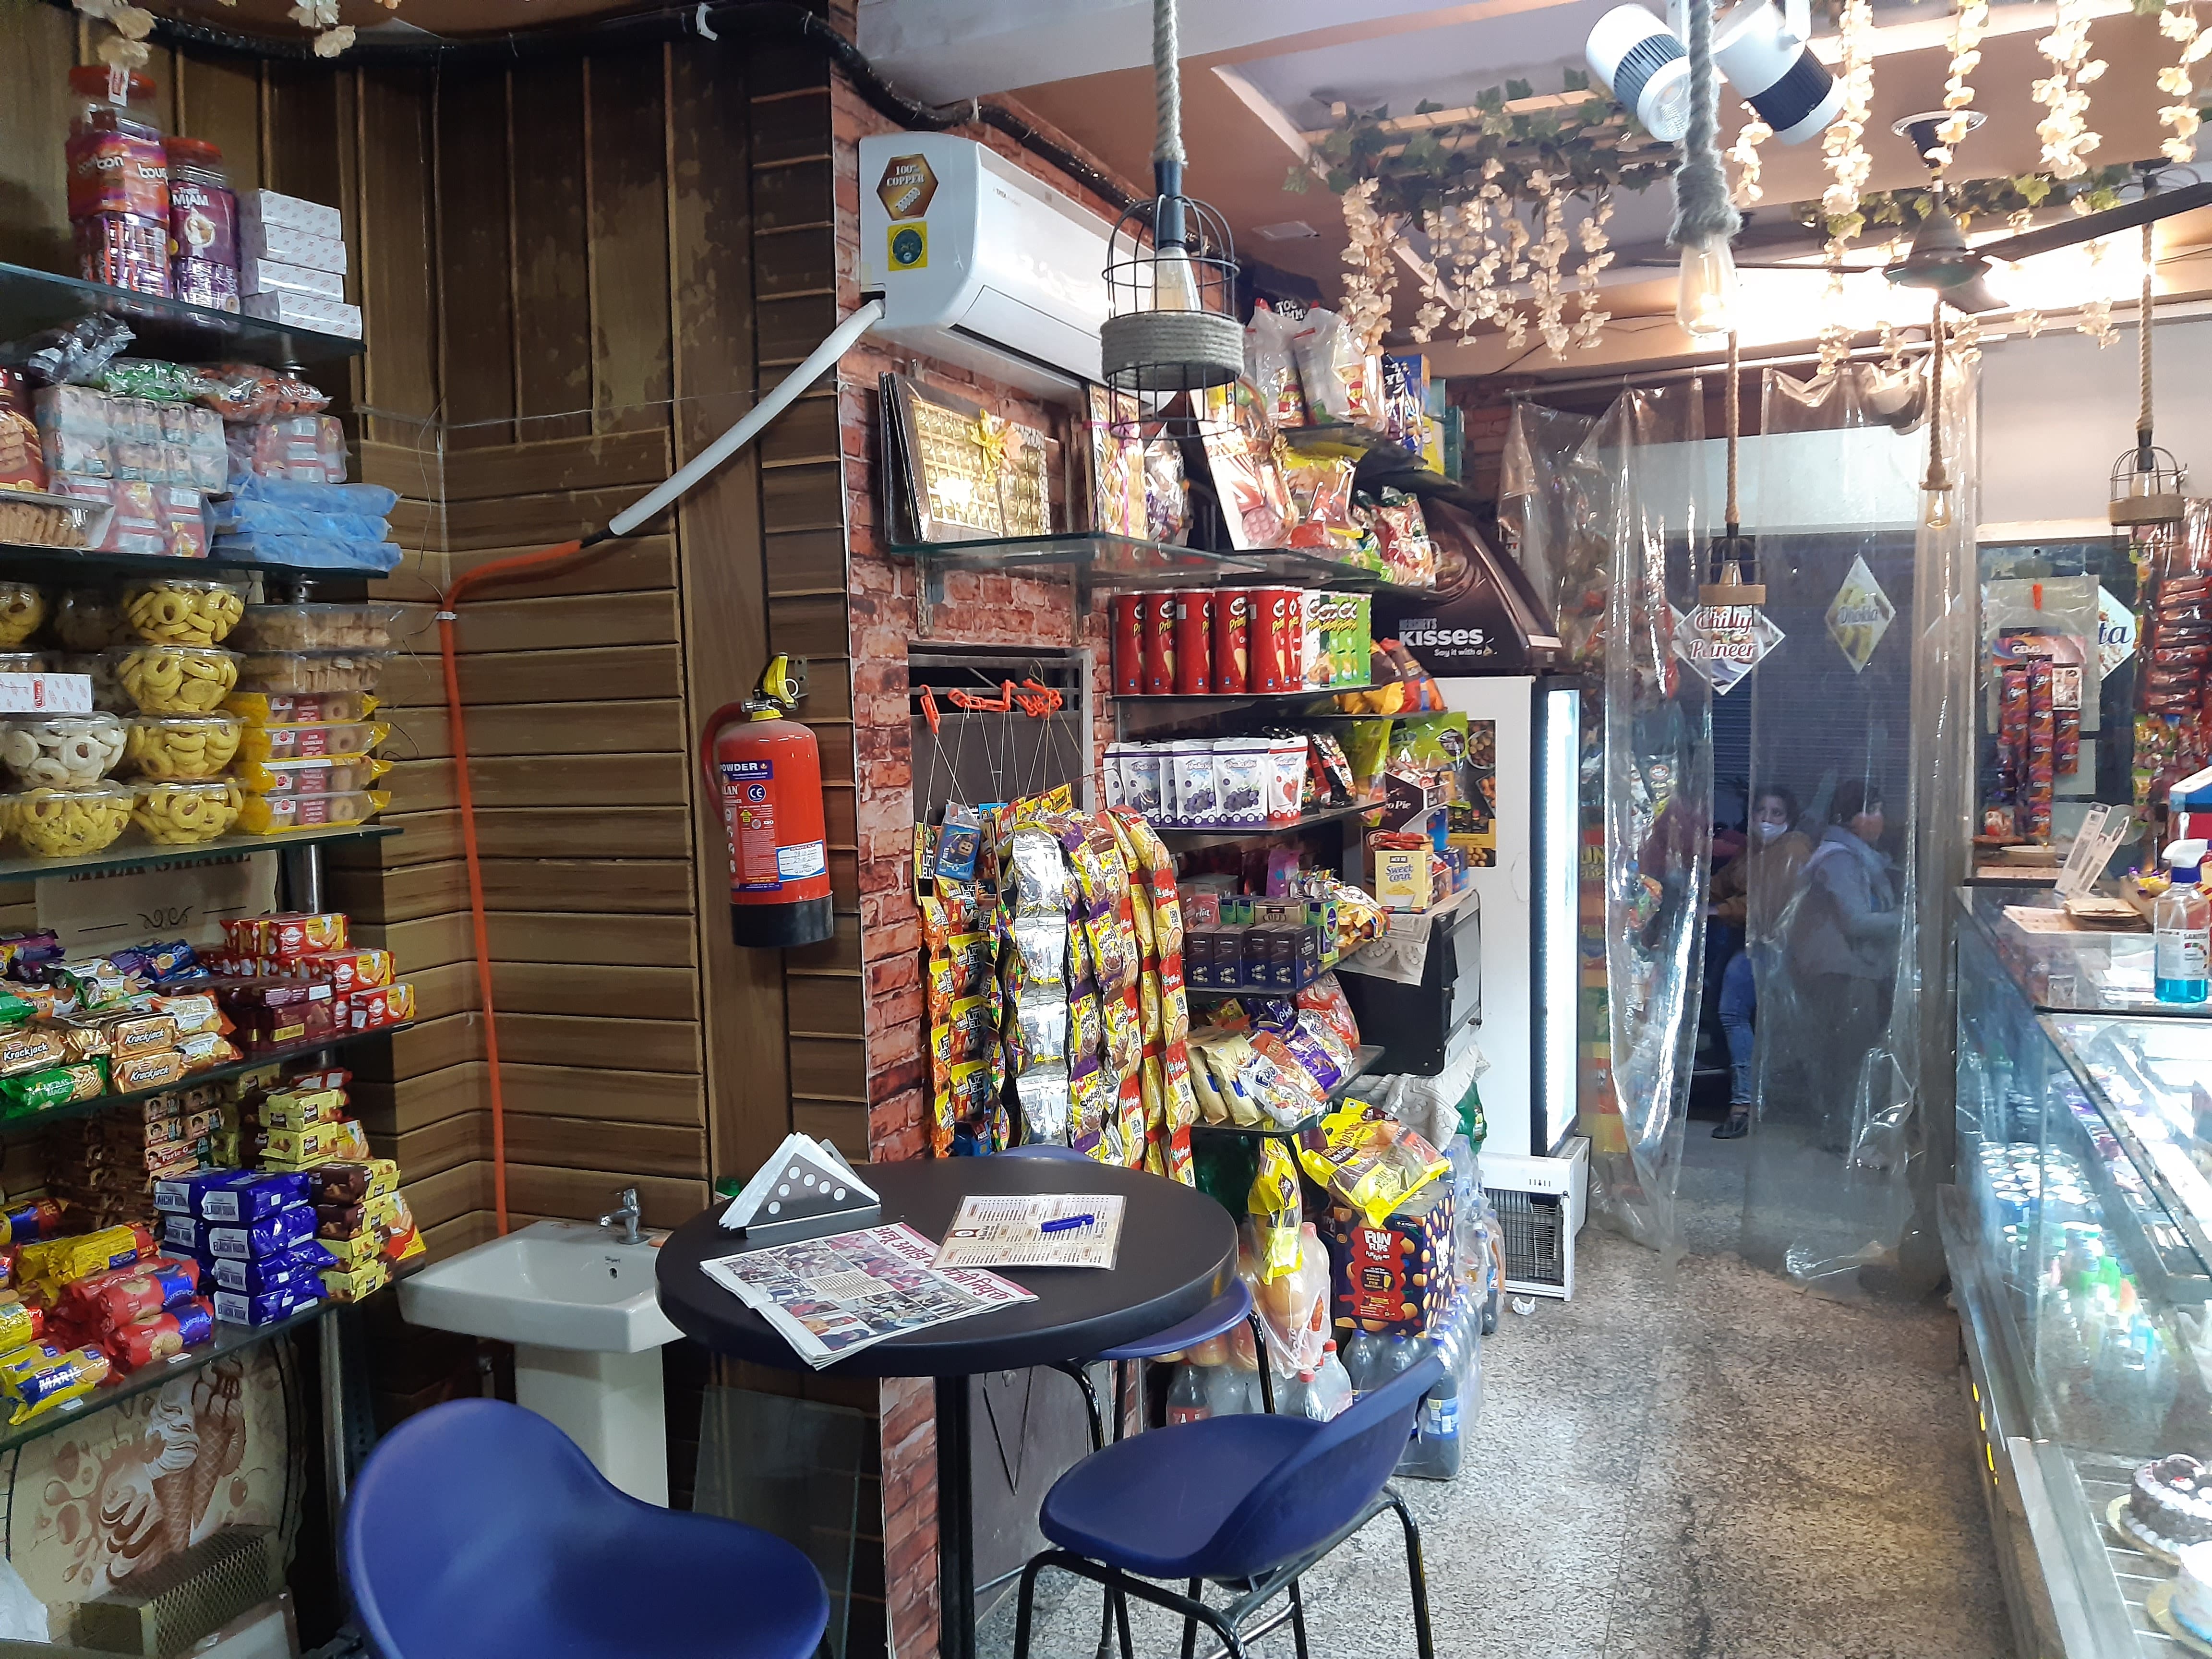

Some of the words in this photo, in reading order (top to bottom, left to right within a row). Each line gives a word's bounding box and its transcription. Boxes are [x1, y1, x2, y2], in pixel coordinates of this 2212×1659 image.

[887, 174, 924, 187] COPPER
[1694, 609, 1754, 634] Chilly
[750, 788, 763, 798] CE
[1385, 864, 1413, 876] Sweet
[1389, 873, 1412, 882] corn
[125, 1027, 165, 1045] Krackjack
[4, 1042, 49, 1061] Krackjack
[130, 1065, 169, 1082] Krackjack
[162, 1152, 181, 1162] Parle
[1364, 1230, 1392, 1246] FUN
[1369, 1243, 1388, 1252] FLIPS
